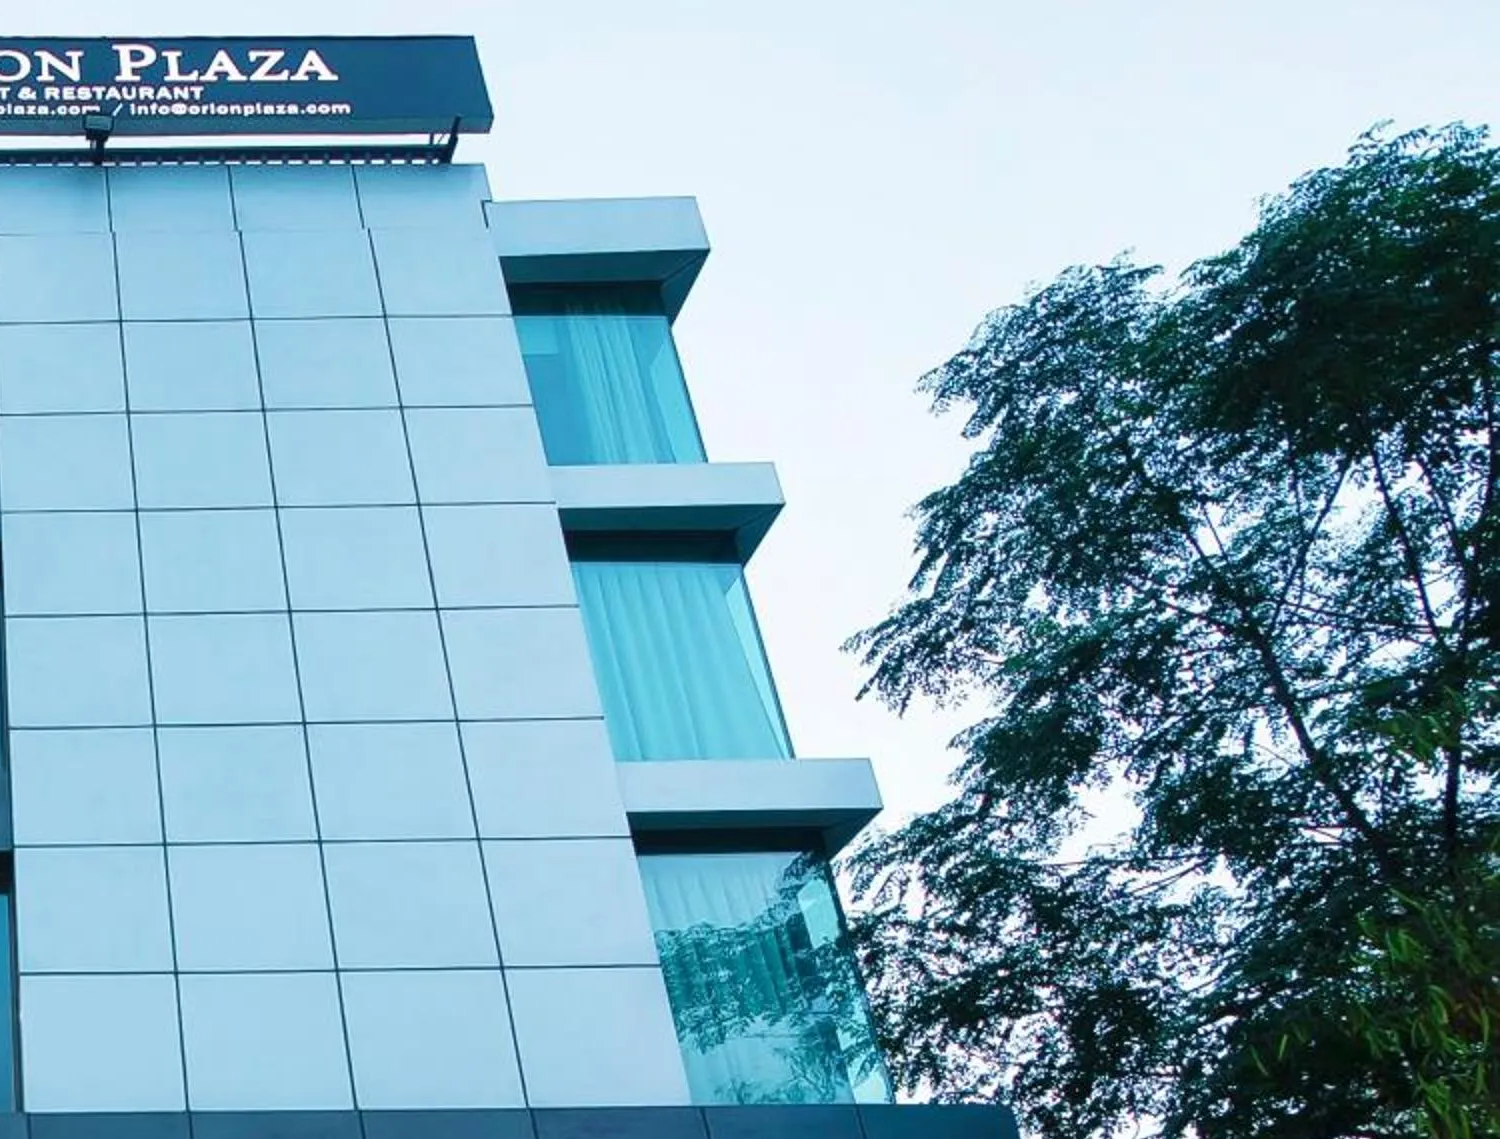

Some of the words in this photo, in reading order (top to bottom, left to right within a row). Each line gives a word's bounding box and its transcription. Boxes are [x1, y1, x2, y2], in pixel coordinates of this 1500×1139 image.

[112, 43, 338, 82] PLAZA
[17, 87, 37, 101] &
[44, 86, 204, 101] RESTAURANT
[130, 102, 352, 118] info@orionplaza.com
